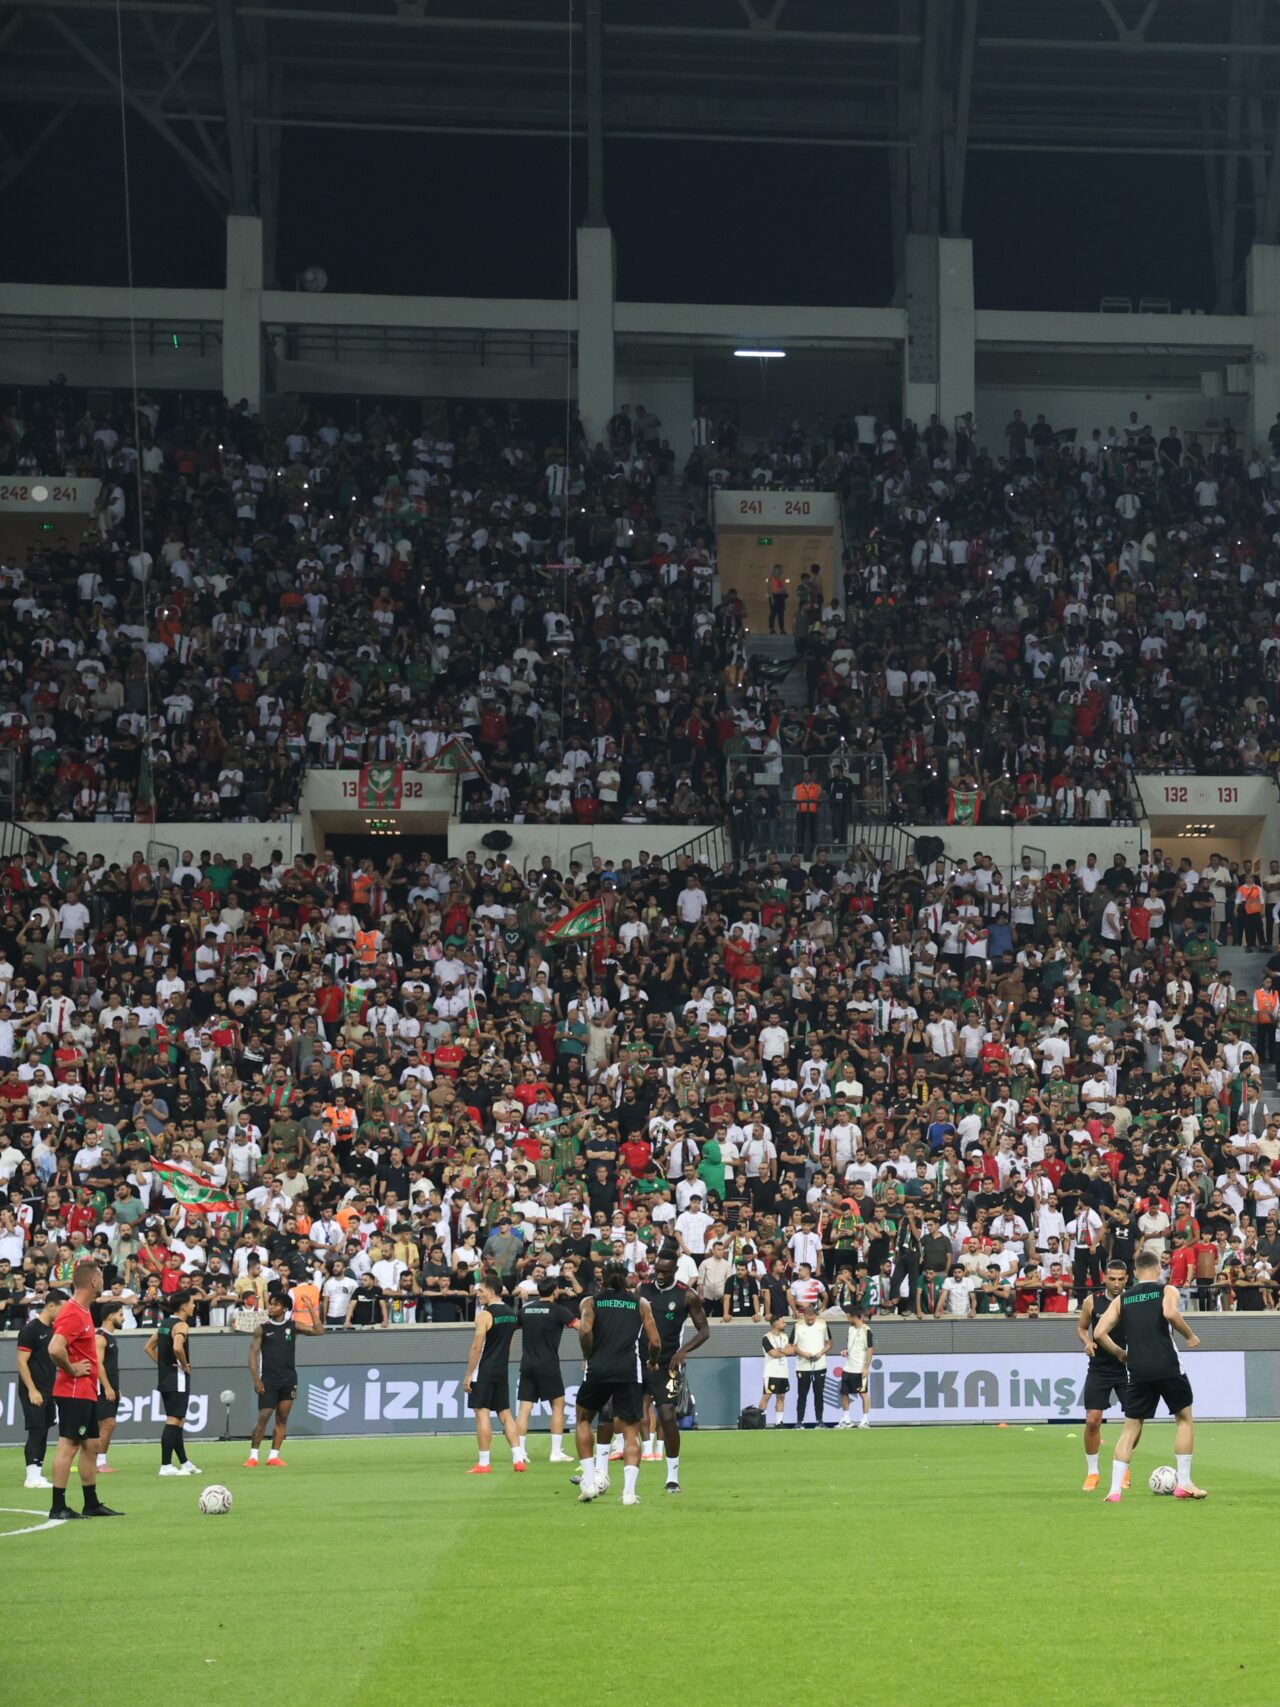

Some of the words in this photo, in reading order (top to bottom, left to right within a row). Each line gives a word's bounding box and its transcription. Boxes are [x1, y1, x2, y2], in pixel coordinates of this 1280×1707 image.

[1, 486, 28, 500] 242
[53, 487, 77, 501] 241
[740, 500, 762, 514] 241
[785, 501, 810, 515] 240
[342, 781, 357, 797] 13
[404, 782, 422, 797] 32
[1164, 786, 1188, 802] 132
[1217, 787, 1238, 803] 131
[596, 1299, 636, 1310] AMEDSPOR
[1123, 1291, 1160, 1305] AMEDSPOR
[364, 1368, 498, 1420] İZK
[870, 1359, 999, 1409] İZKA
[1010, 1369, 1122, 1415] İNŞ
